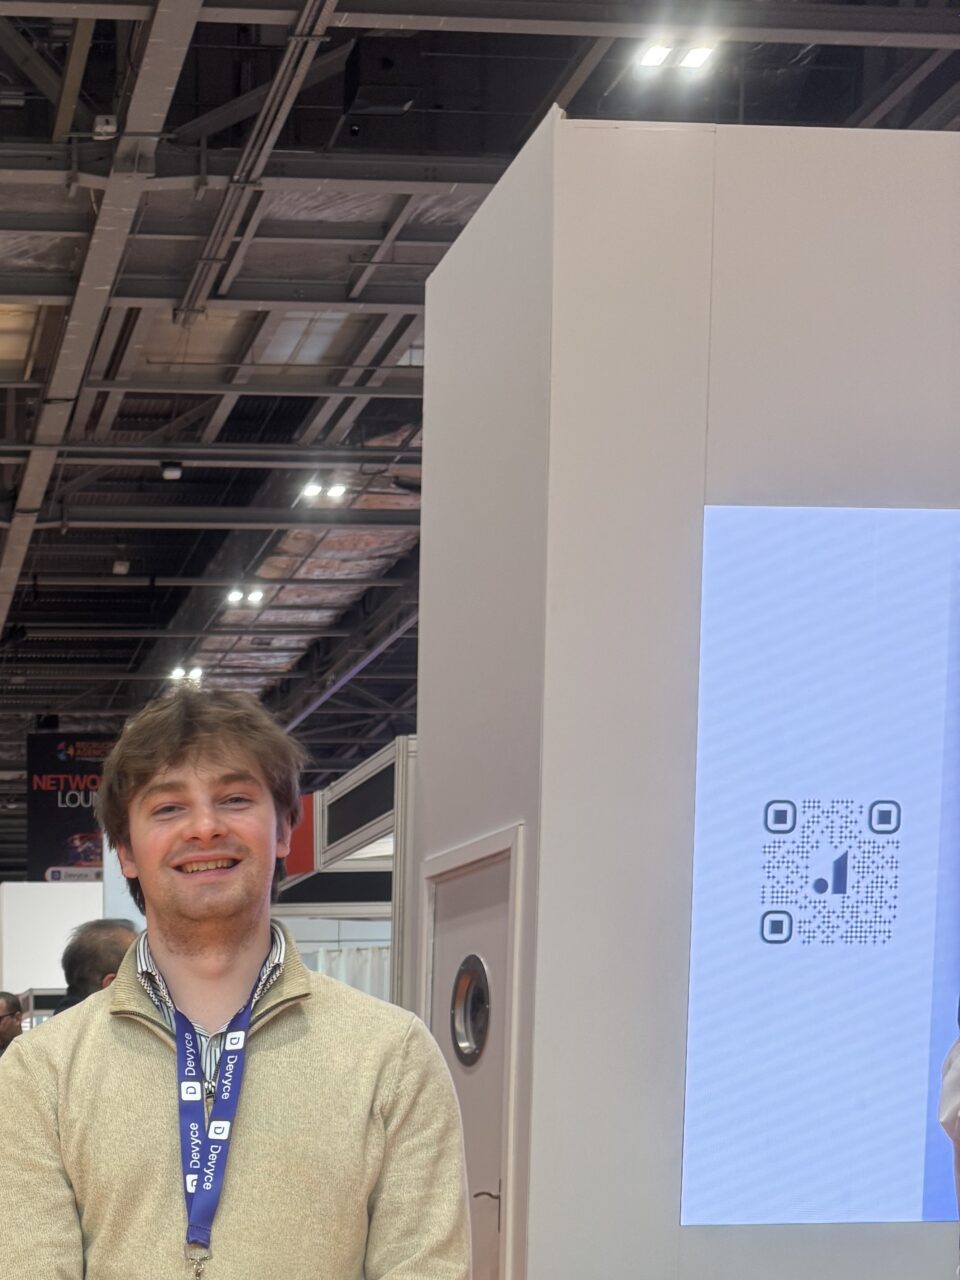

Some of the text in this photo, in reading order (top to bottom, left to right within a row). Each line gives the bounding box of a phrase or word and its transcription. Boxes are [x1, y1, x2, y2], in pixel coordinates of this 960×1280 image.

[32, 773, 104, 790] NETWO
[185, 1033, 196, 1076] Devyce
[222, 1055, 238, 1099] Devyce
[189, 1122, 201, 1168] Devyce
[203, 1145, 222, 1190] Devyce
